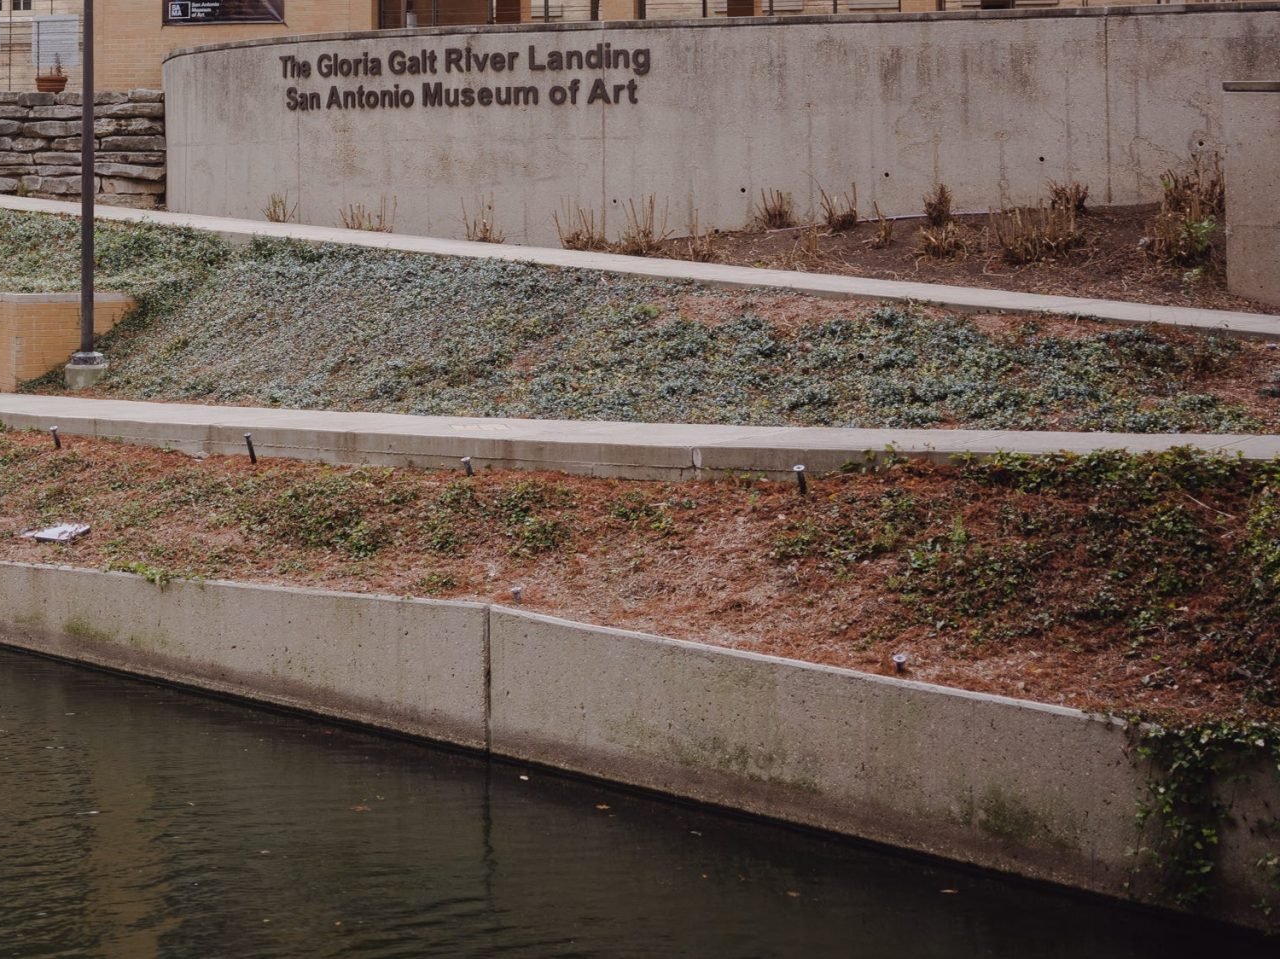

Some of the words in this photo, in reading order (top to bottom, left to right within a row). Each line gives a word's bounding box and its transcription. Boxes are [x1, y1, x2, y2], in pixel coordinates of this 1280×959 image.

[280, 55, 311, 79] The
[317, 51, 382, 78] Gloria
[388, 50, 438, 75] Galt
[445, 47, 520, 73] River
[528, 43, 651, 75] Landing
[285, 86, 321, 110] San
[326, 84, 415, 109] Antonio
[422, 81, 539, 107] Museum
[549, 79, 580, 105] of
[587, 78, 639, 105] Art
